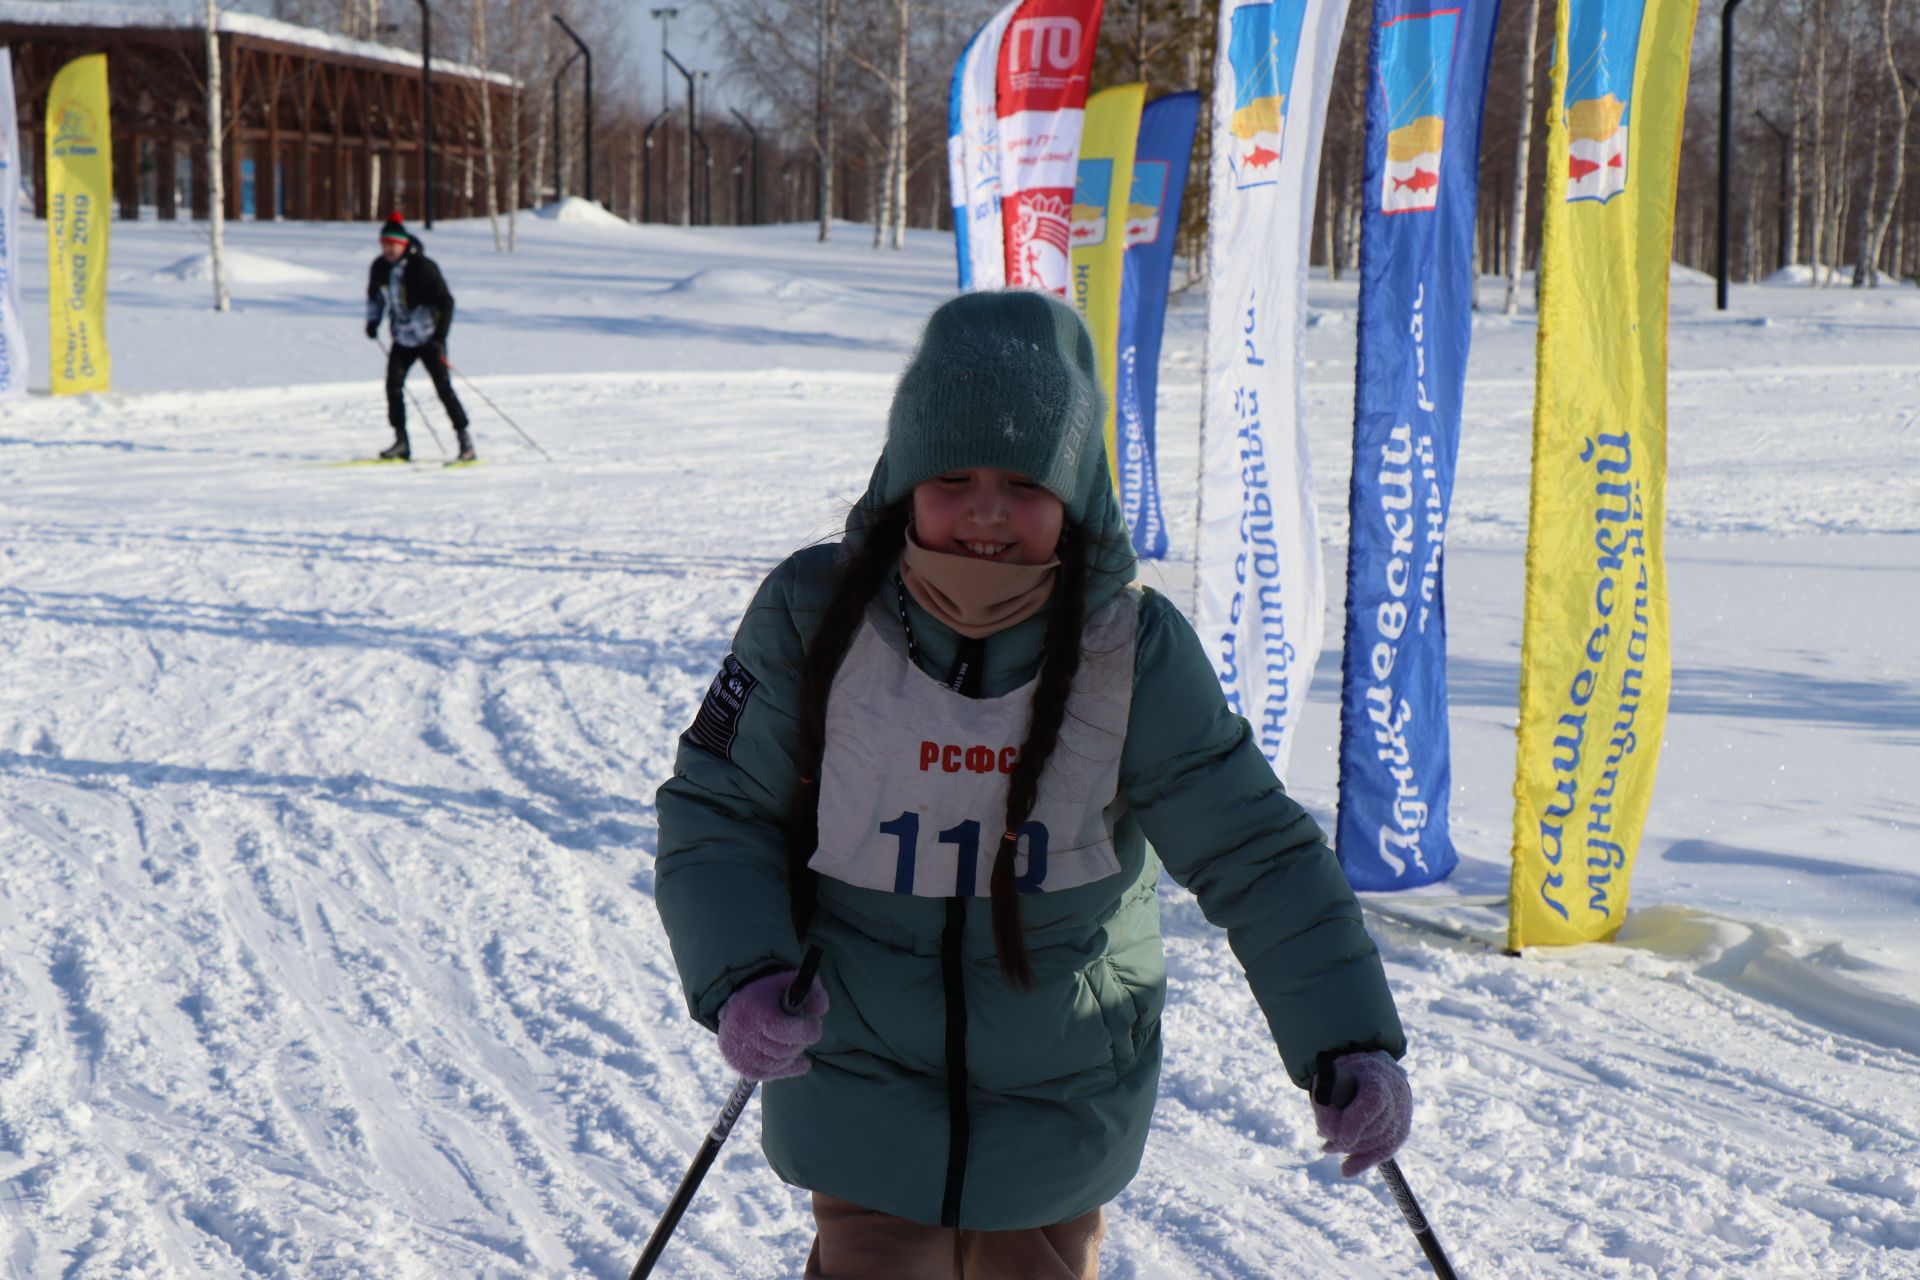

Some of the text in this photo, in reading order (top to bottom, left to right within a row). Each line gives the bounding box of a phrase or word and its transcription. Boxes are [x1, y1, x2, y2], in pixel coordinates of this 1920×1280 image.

[72, 193, 90, 246] 2019
[719, 689, 741, 711] FUTURE
[919, 741, 1024, 775] РСФС
